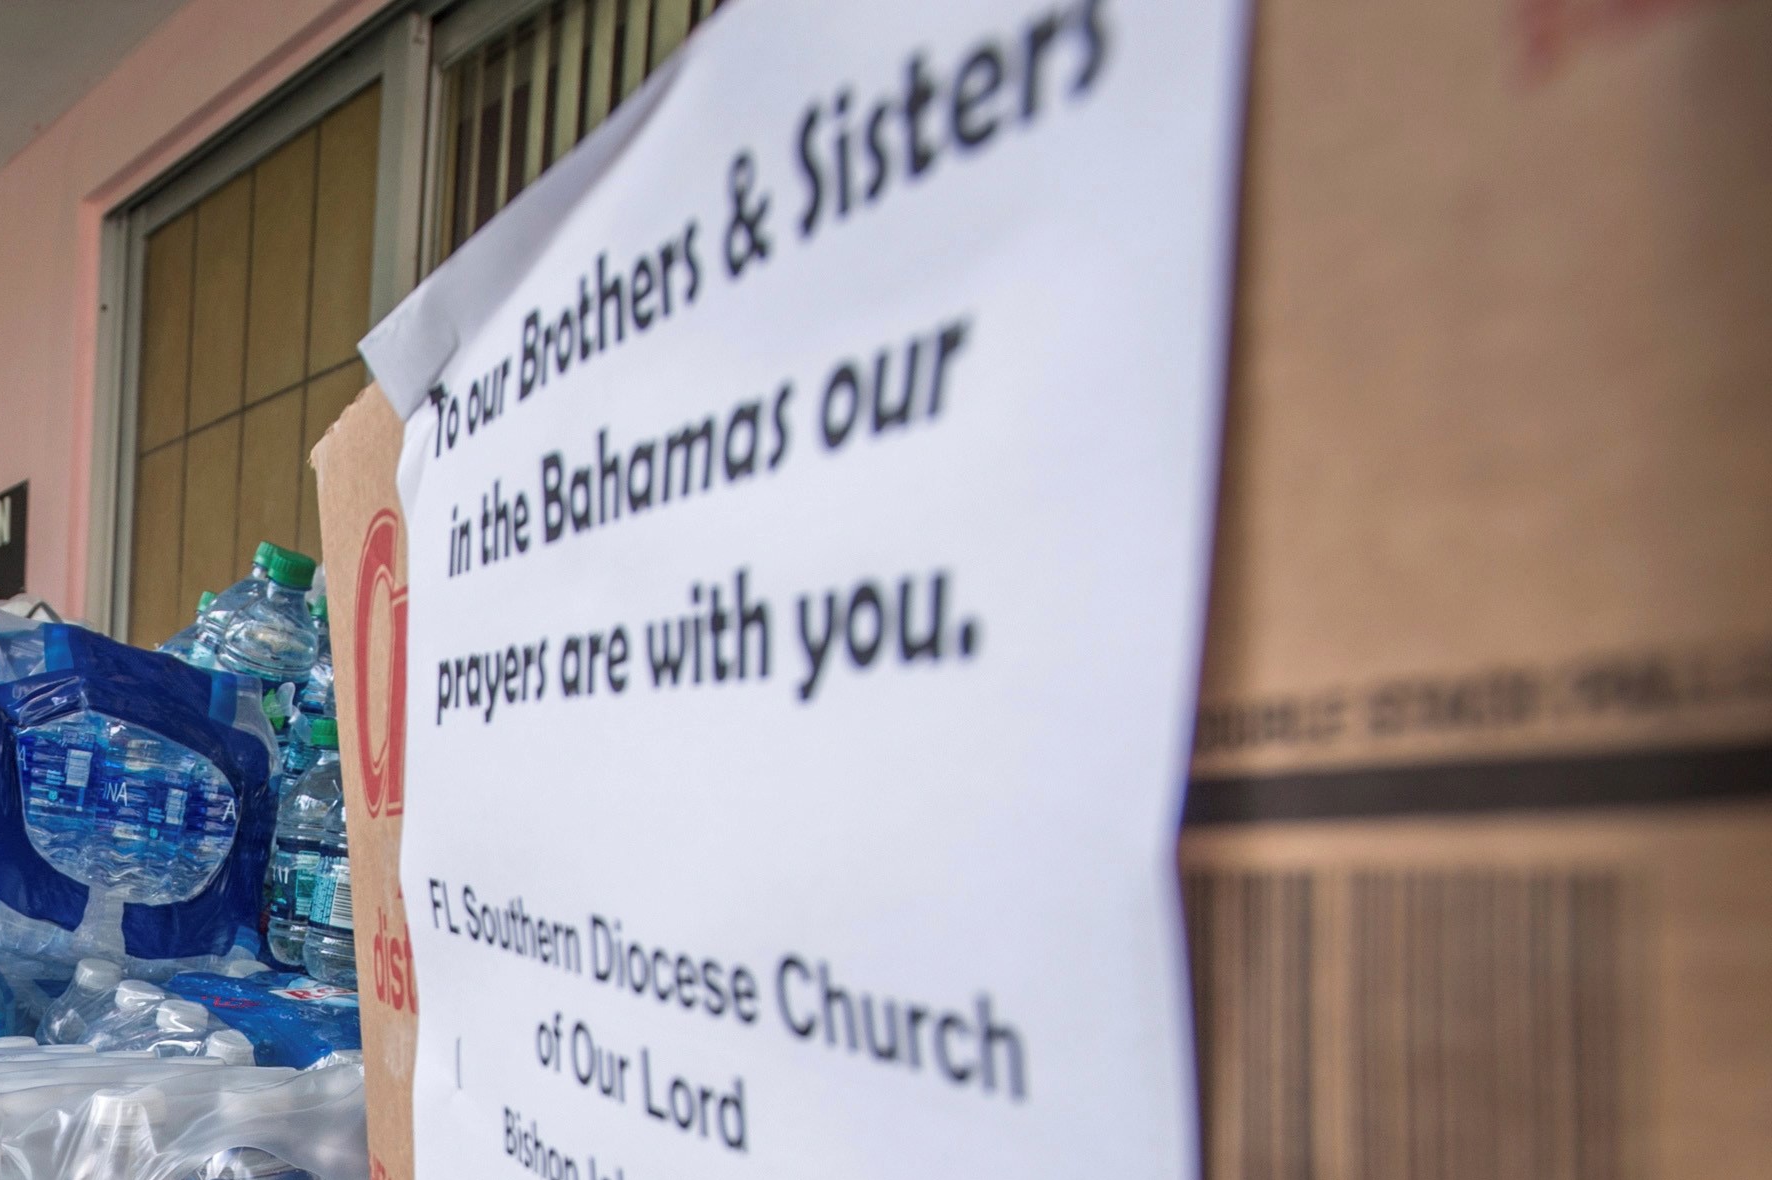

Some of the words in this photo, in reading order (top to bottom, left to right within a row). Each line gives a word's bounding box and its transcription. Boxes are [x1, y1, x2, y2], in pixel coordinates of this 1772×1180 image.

[430, 383, 460, 457] To
[466, 354, 510, 436] our
[519, 220, 700, 402] Brothers
[723, 150, 773, 281] &
[796, 0, 1113, 239] Sisters
[448, 505, 472, 578] in
[481, 479, 531, 565] the
[541, 380, 794, 545] Bahamas
[820, 316, 972, 452] our
[436, 636, 548, 726] prayers
[560, 625, 630, 697] are
[647, 568, 773, 689] with
[797, 568, 982, 703] you.
[429, 877, 460, 937] FL
[463, 885, 582, 978] Southern
[591, 914, 760, 1026] Diocese
[775, 952, 1031, 1105] Church
[535, 1012, 564, 1070] of
[570, 1028, 631, 1100] Our
[642, 1047, 750, 1153] Lord
